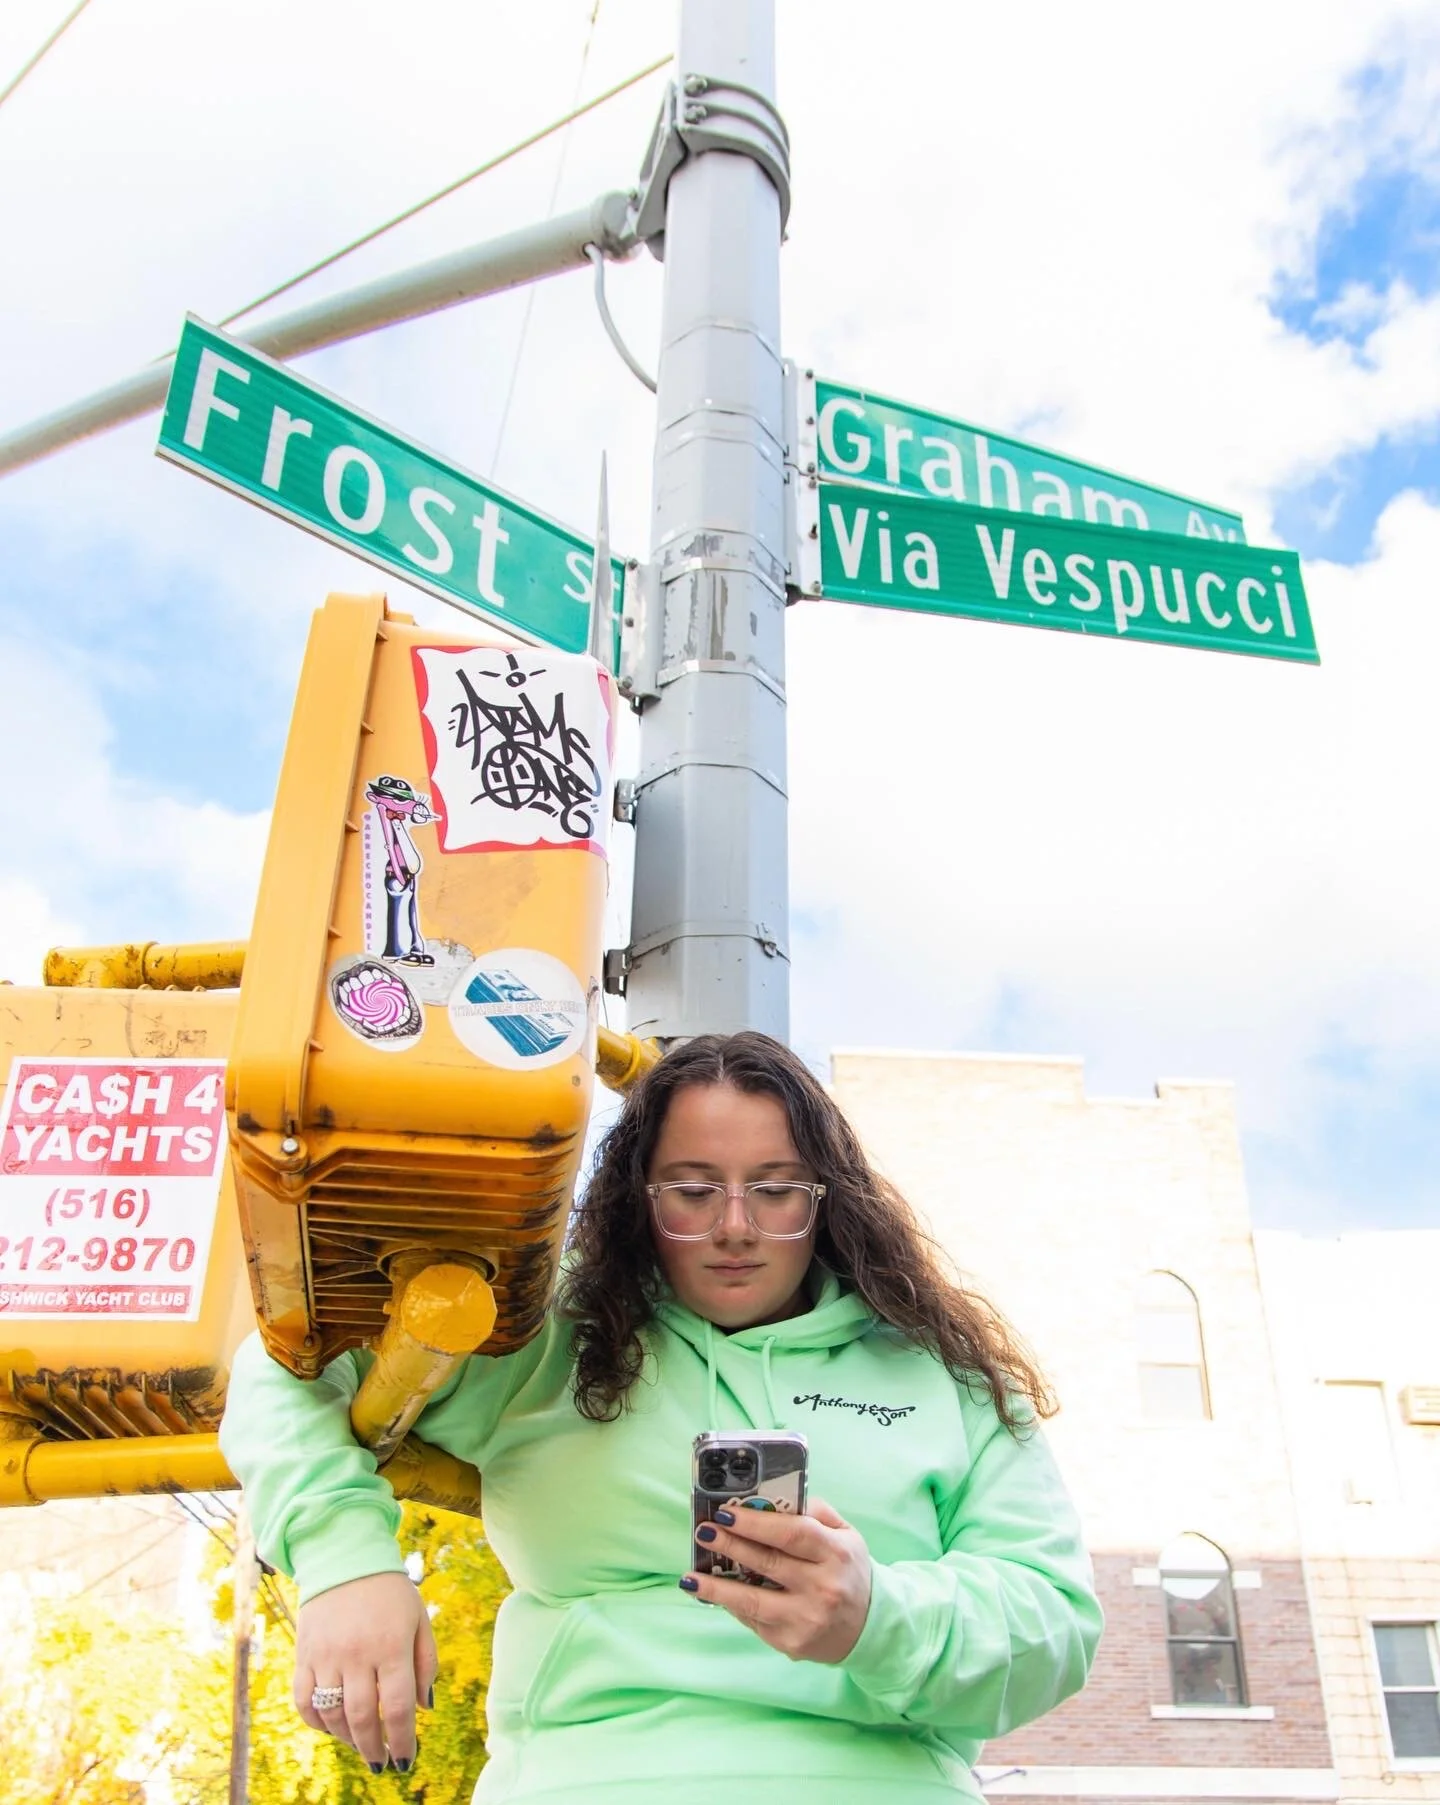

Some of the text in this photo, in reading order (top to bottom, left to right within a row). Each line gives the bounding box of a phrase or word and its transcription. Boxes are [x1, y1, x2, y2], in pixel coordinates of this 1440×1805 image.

[183, 347, 510, 608] Frost
[818, 398, 1150, 531] Graham
[828, 504, 1297, 637] Via Vespucci
[18, 1072, 219, 1119] CA$H 4
[13, 1125, 213, 1163] YACHTS
[45, 1188, 151, 1228] (516)
[75, 1291, 132, 1306] YACHT
[138, 1291, 186, 1307] CLUB
